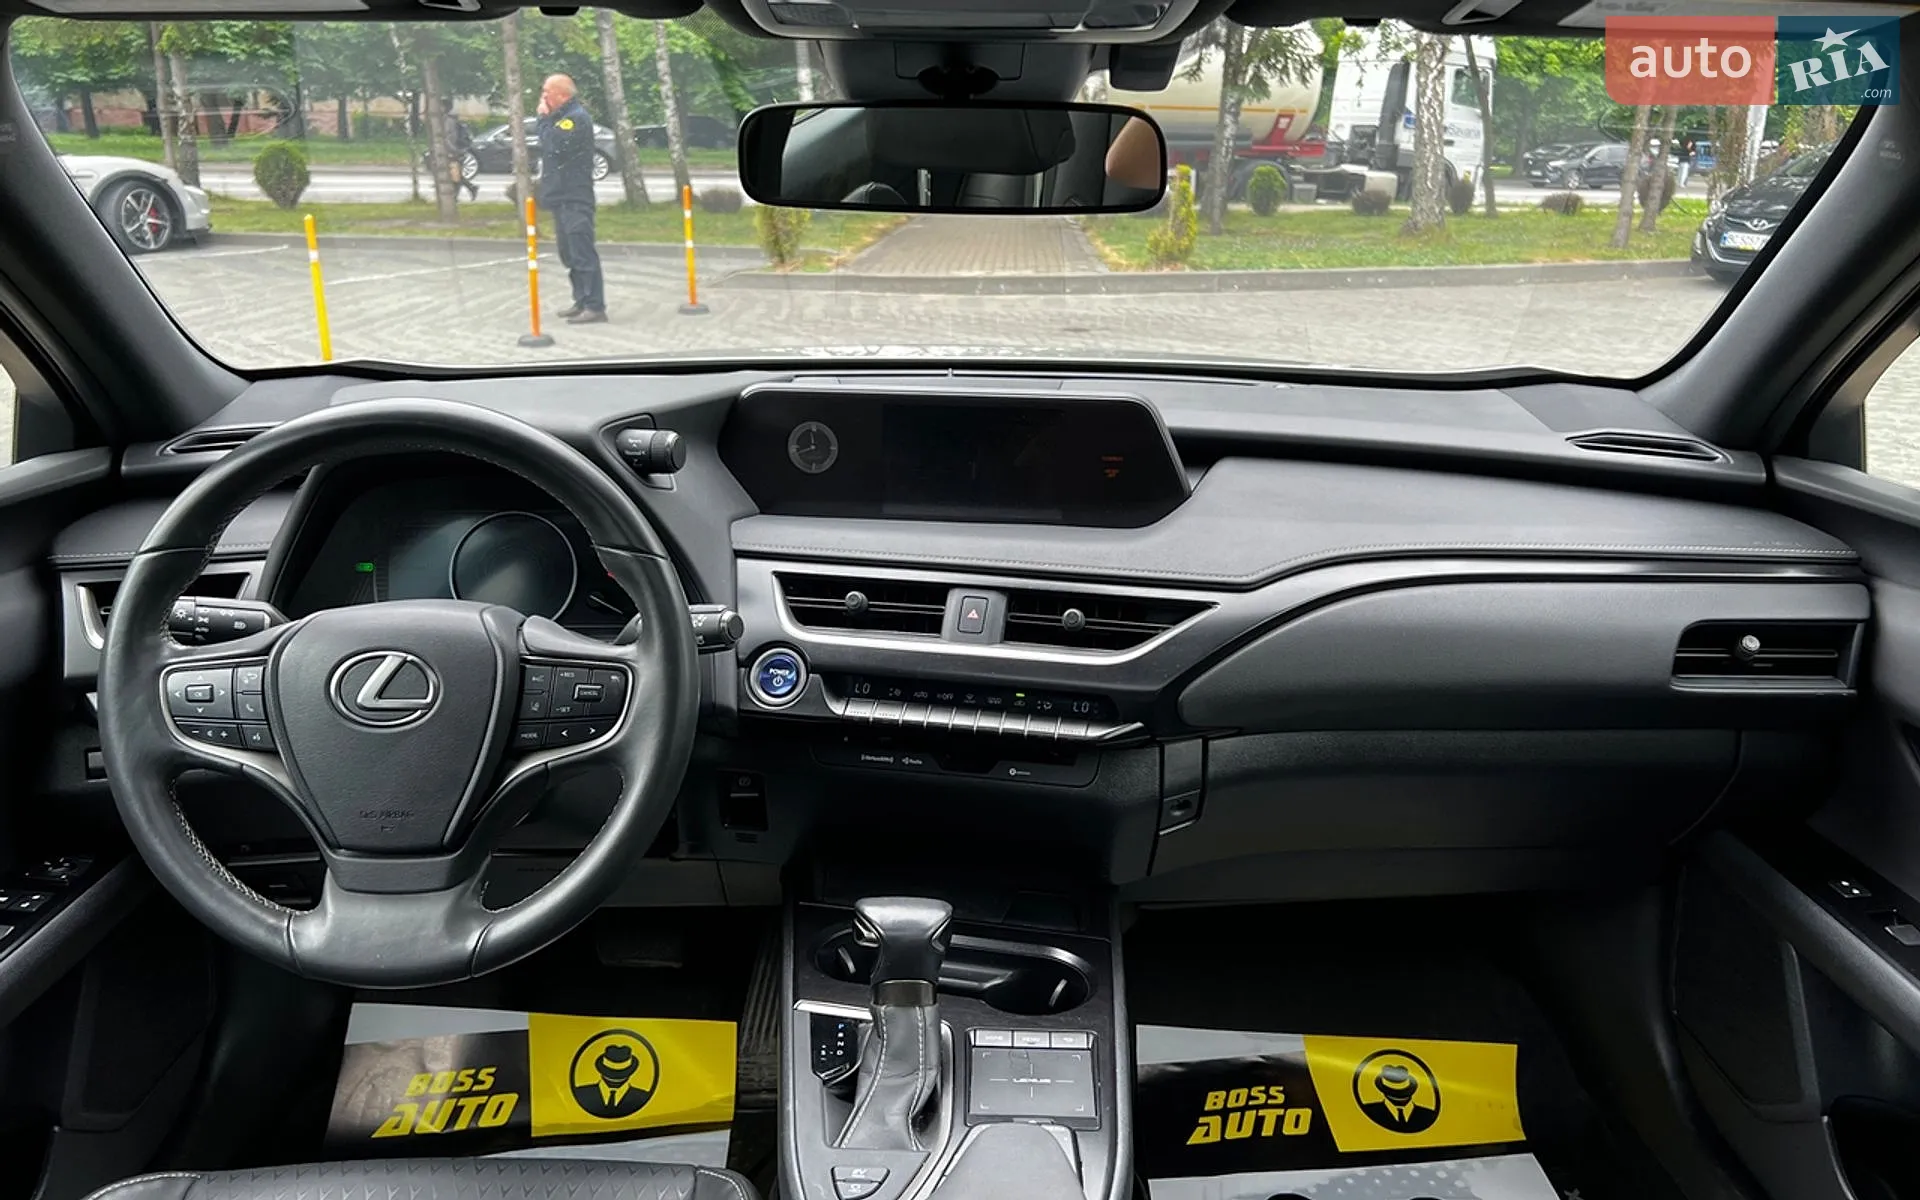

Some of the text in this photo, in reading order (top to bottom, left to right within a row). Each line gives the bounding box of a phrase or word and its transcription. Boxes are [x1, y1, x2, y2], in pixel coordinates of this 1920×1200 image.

[406, 1067, 497, 1097] BOSS
[1204, 1085, 1285, 1111] BOSS
[371, 1093, 519, 1138] AUTO
[1186, 1108, 1312, 1145] AUTO
